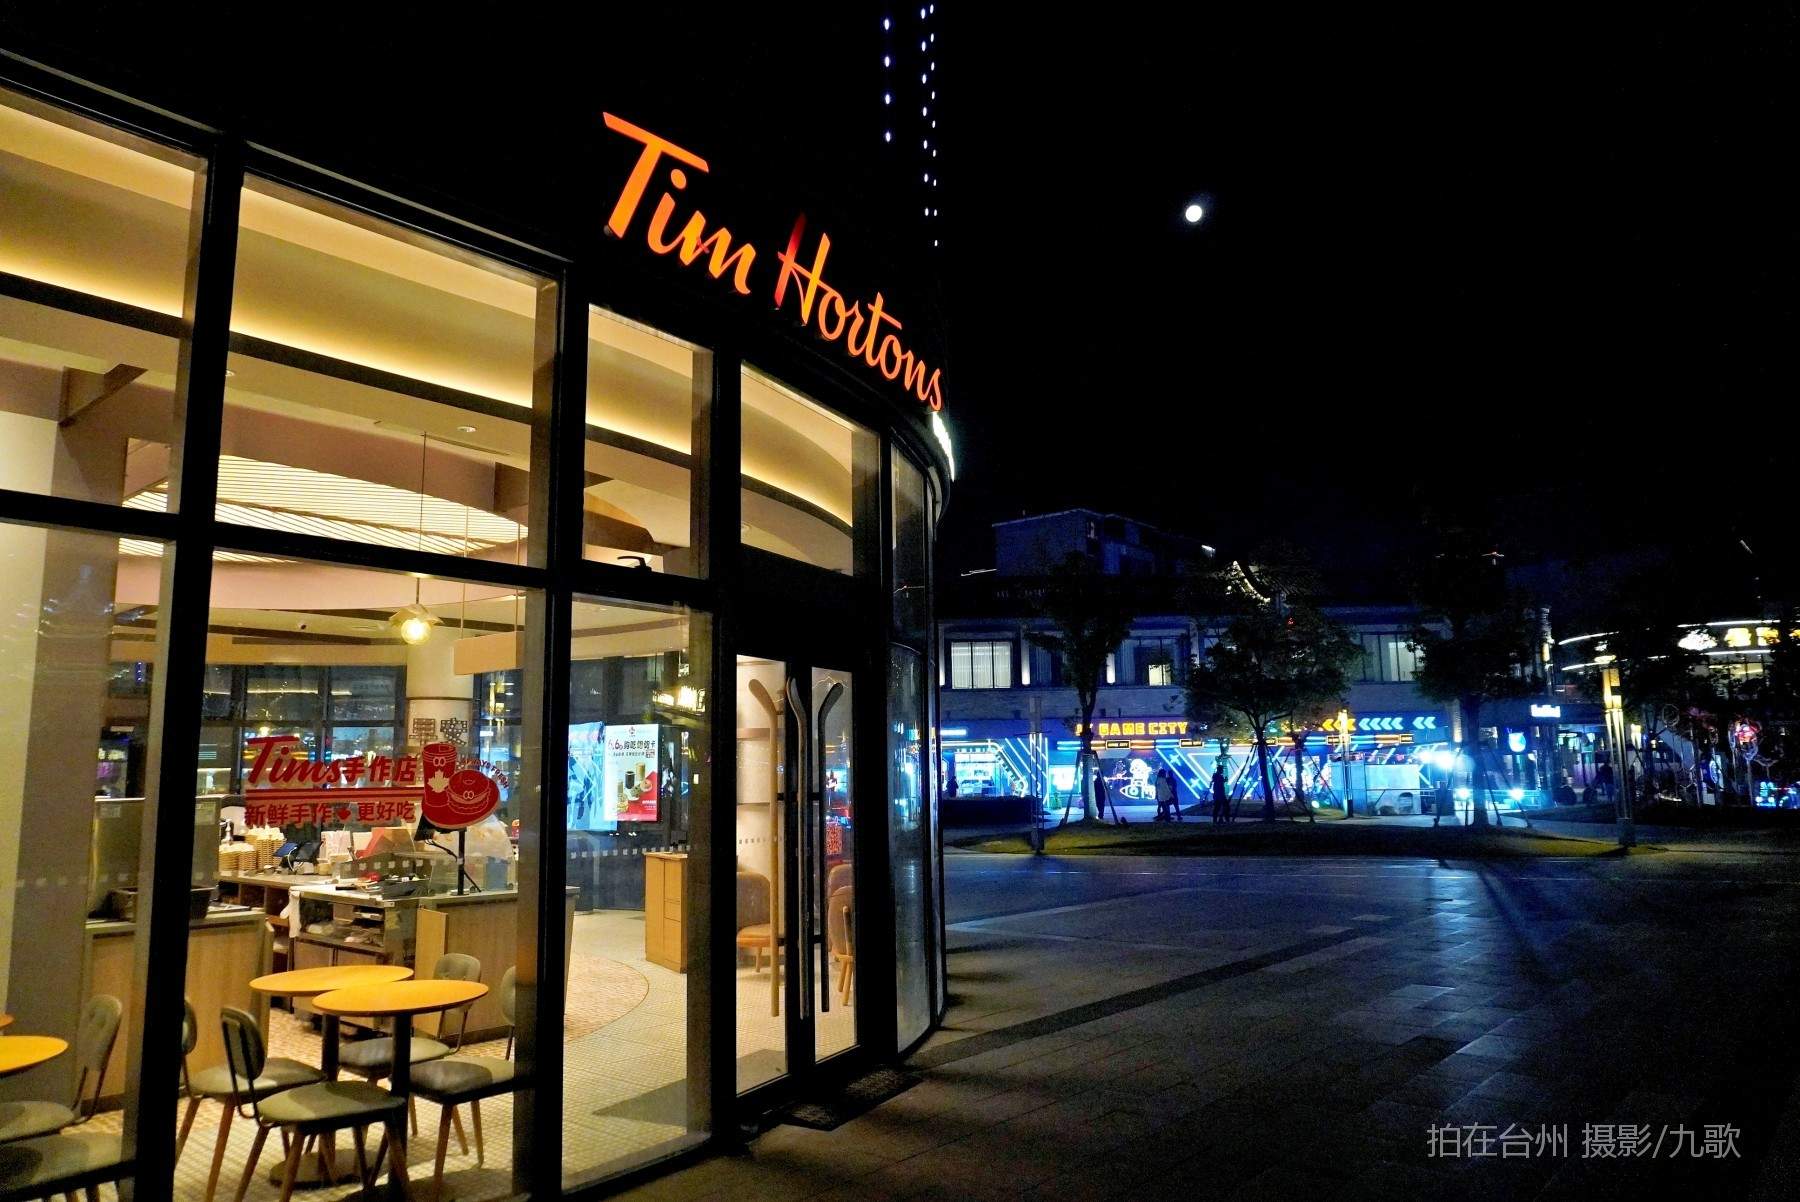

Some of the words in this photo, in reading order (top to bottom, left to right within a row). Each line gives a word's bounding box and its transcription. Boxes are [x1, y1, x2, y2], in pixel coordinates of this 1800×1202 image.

[602, 111, 757, 295] Tim
[774, 212, 943, 413] Hortons
[1098, 722, 1146, 736] GAME
[1149, 721, 1188, 735] CITY
[246, 736, 342, 785] Tims
[244, 804, 334, 827] 新鲜手作
[356, 802, 416, 824] 更好吃
